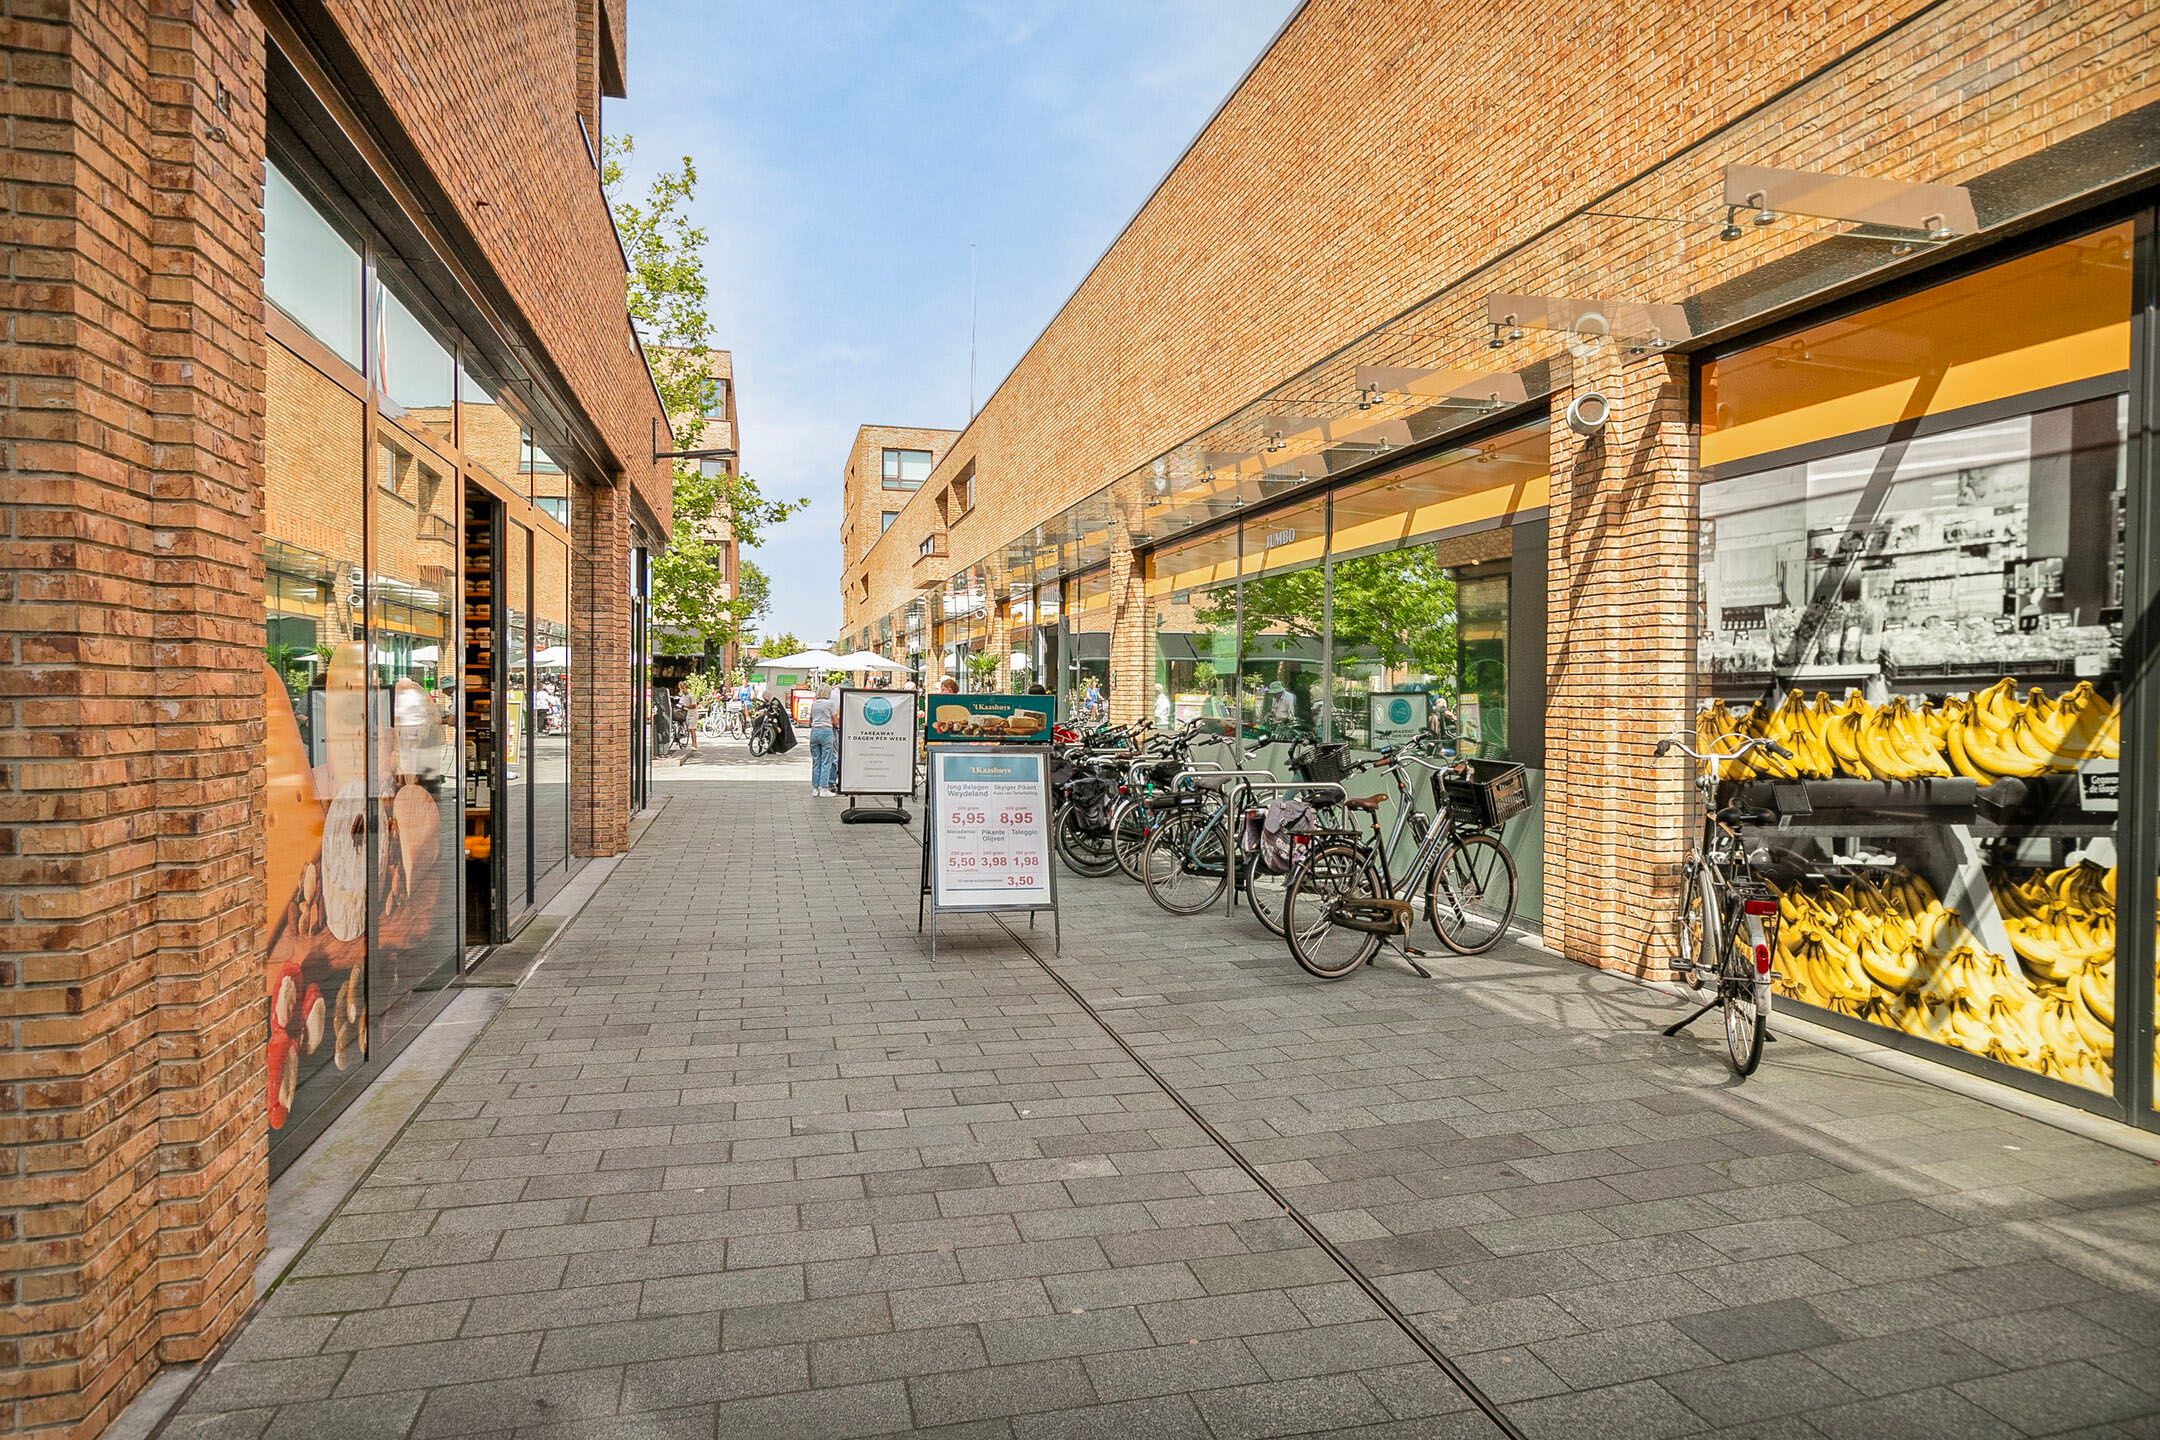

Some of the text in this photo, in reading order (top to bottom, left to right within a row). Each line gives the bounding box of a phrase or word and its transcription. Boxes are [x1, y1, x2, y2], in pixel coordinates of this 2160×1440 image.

[1266, 528, 1296, 549] JUMBO
[978, 703, 1011, 712] Kaashuys
[947, 790, 989, 798] Weydeland
[951, 812, 986, 826] 5,95
[999, 812, 1033, 826] 8,95
[981, 828, 1006, 836] Pikante
[982, 835, 1005, 843] Olijven
[949, 857, 976, 868] 5,50
[980, 856, 1008, 868] 3,98
[1013, 856, 1039, 867] 1,98
[1007, 876, 1034, 887] 3,50
